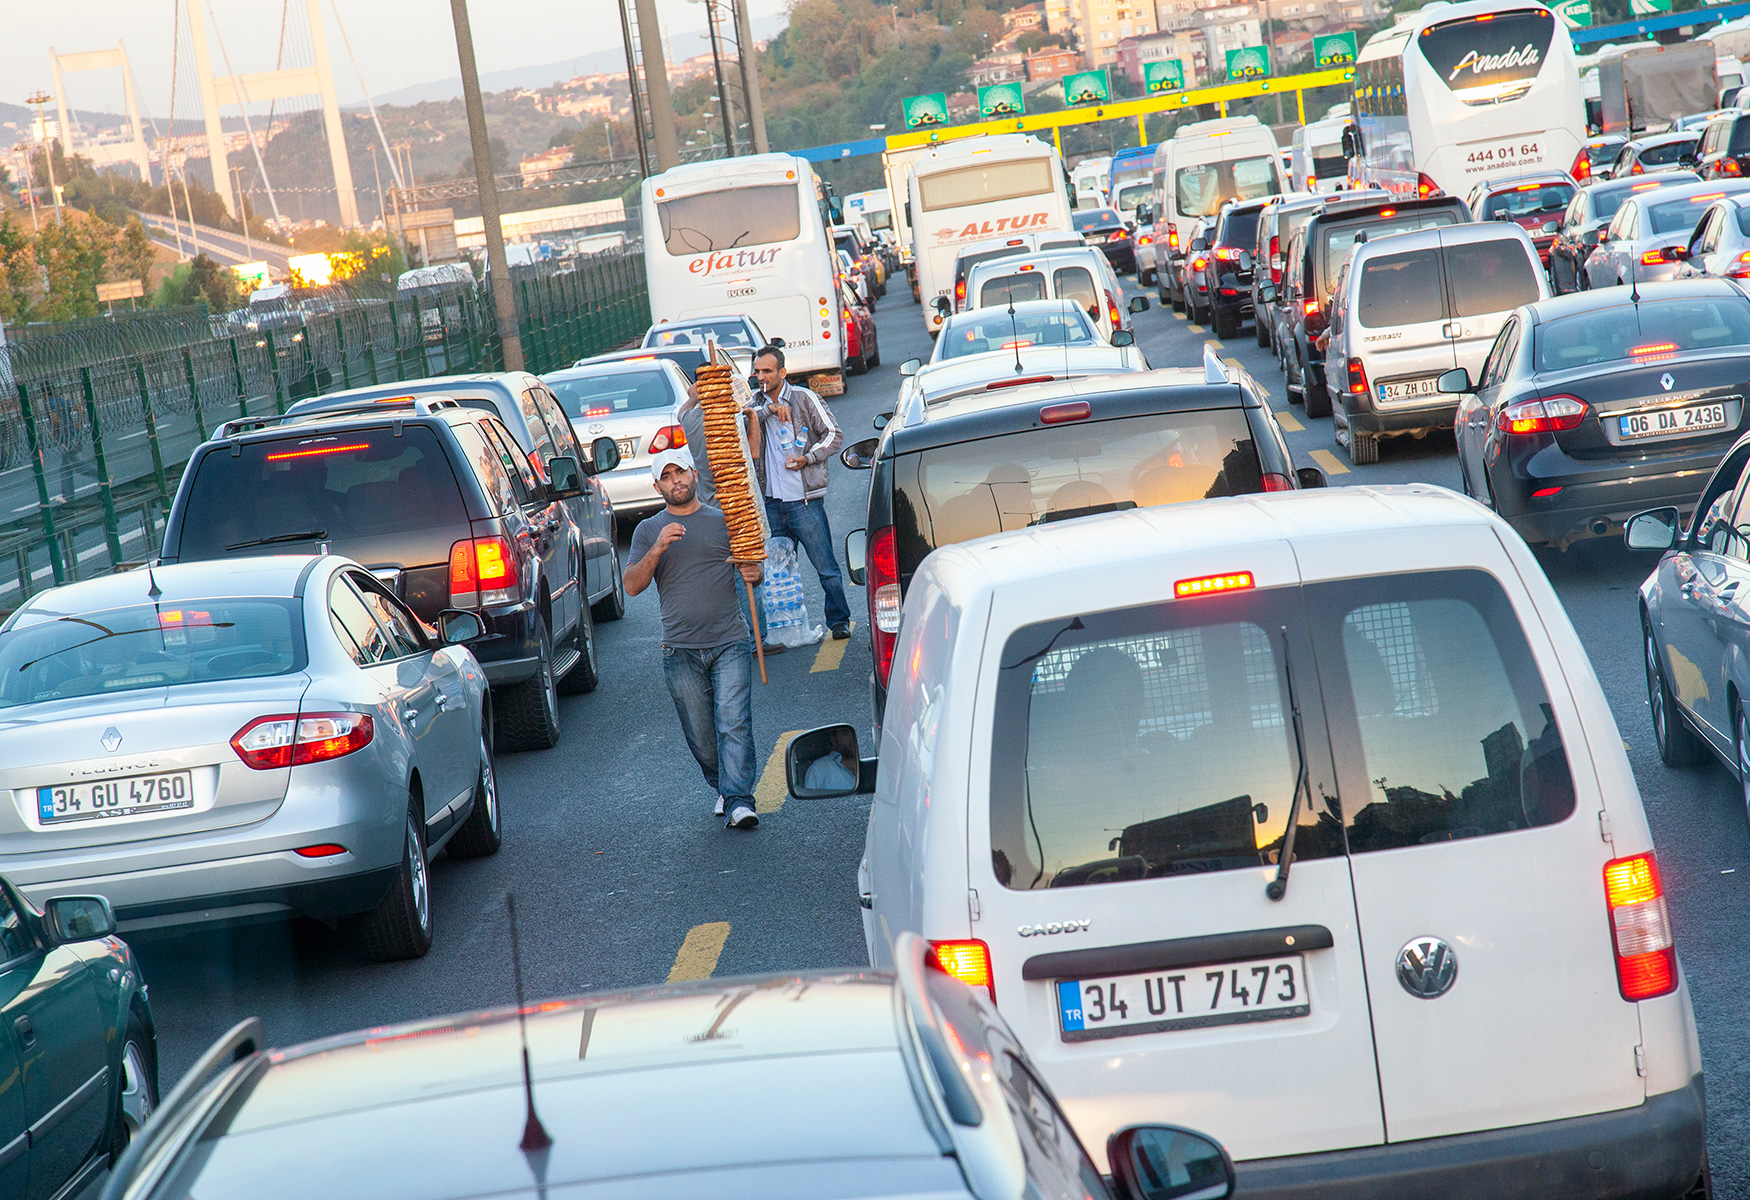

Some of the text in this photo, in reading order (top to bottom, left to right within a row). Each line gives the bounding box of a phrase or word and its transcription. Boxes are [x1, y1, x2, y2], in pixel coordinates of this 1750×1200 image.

[1565, 3, 1589, 16] KGS
[1319, 53, 1354, 65] OGS
[1448, 43, 1540, 82] Anadolu
[1231, 66, 1265, 78] OGS
[1150, 79, 1182, 92] OGS
[1067, 89, 1107, 104] OGS
[982, 102, 1022, 115] OGS
[908, 113, 947, 126] OGS
[1467, 143, 1539, 163] 444 01 64
[1465, 156, 1543, 174] www.anadolu.com.tr
[958, 212, 1049, 238] ALTUR
[688, 247, 782, 278] efatur
[727, 286, 757, 298] IVECO
[1386, 385, 1400, 398] 34
[1404, 382, 1418, 396] ZH
[1421, 380, 1438, 393] 01
[1638, 392, 1701, 406] FLUENCE
[1629, 415, 1649, 433] 06
[1658, 411, 1678, 430] DA
[1684, 406, 1722, 426] 2436
[69, 759, 160, 777] FLUENCE
[42, 776, 186, 813] TR 34 GU 4760
[1016, 918, 1093, 938] CADDY
[1065, 1008, 1082, 1021] TR
[1084, 982, 1128, 1023] 34
[1144, 975, 1187, 1016] UT
[1205, 964, 1297, 1010] 7473
